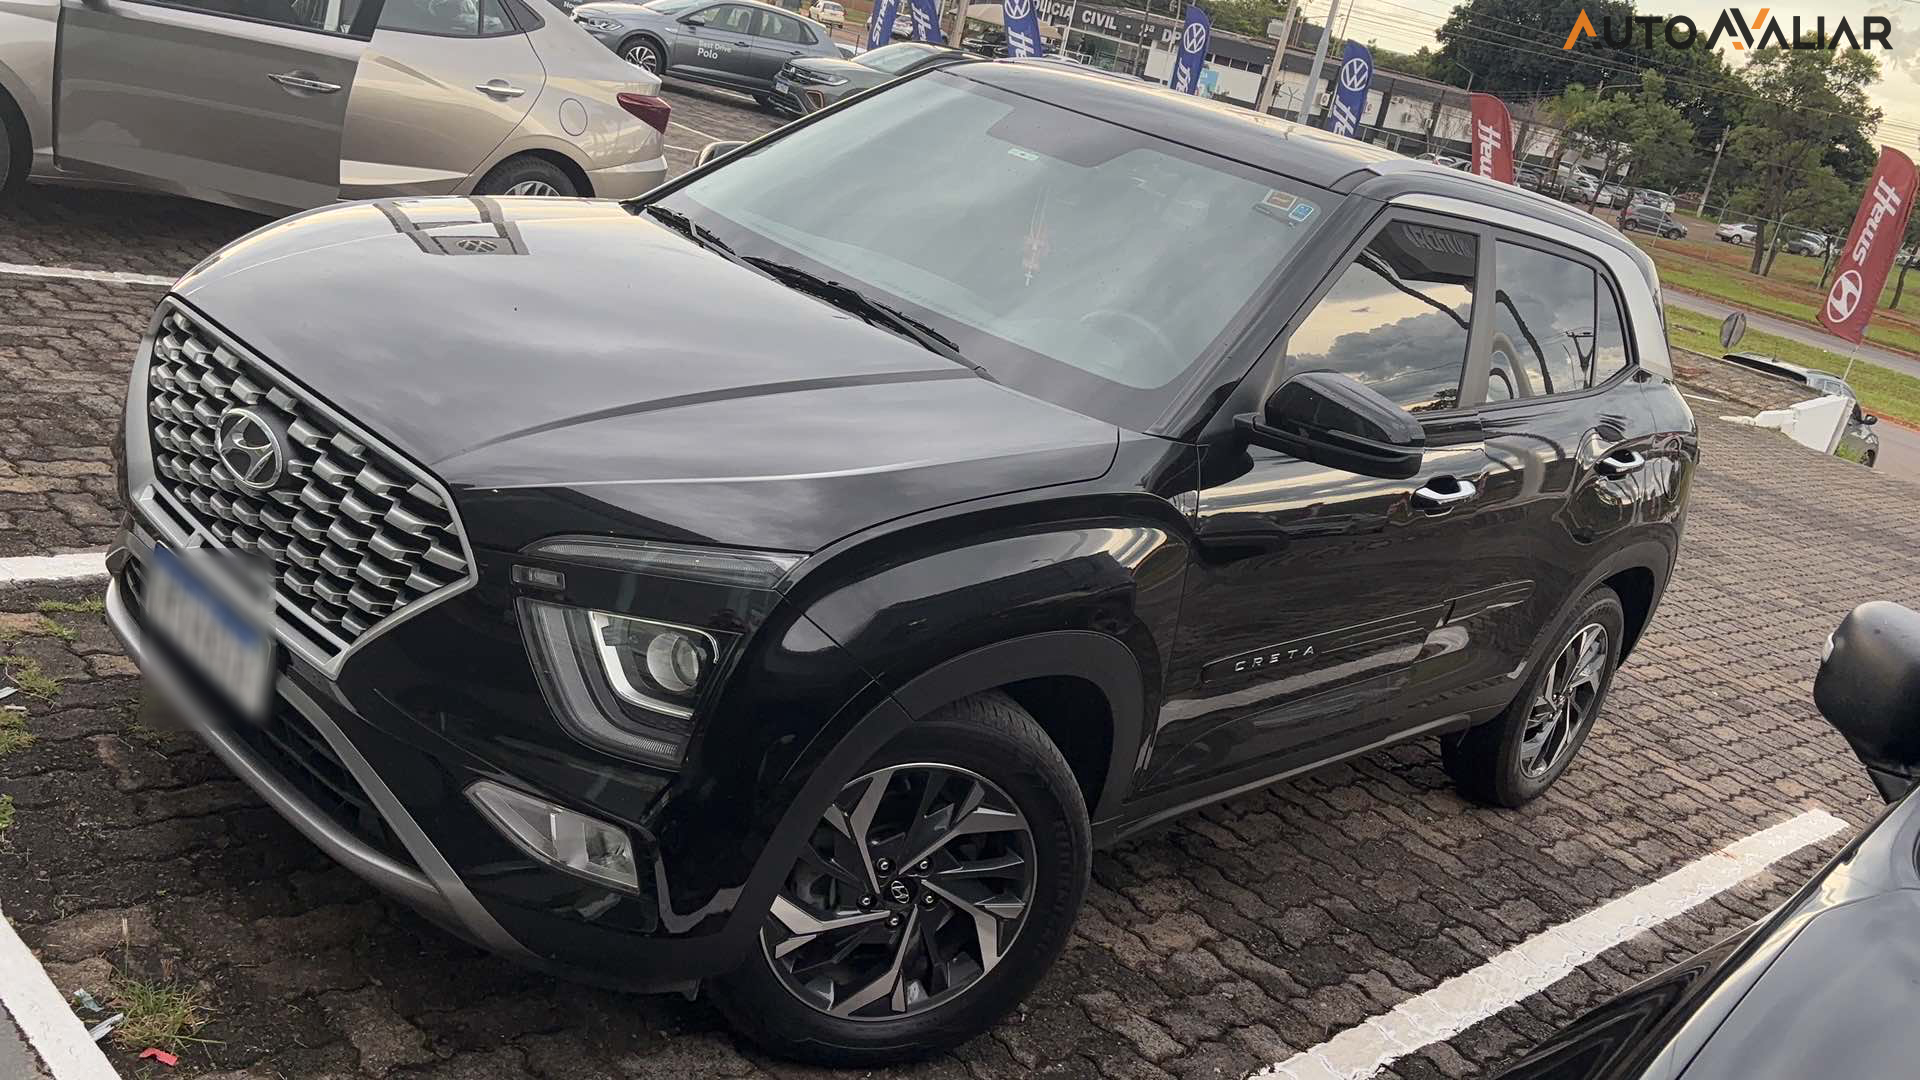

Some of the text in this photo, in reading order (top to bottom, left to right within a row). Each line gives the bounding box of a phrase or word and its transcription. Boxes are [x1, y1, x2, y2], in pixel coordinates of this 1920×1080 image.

[1082, 9, 1117, 31] CIVIL
[1161, 28, 1182, 45] DP
[697, 47, 718, 59] Polo
[1234, 645, 1315, 671] CRETA
